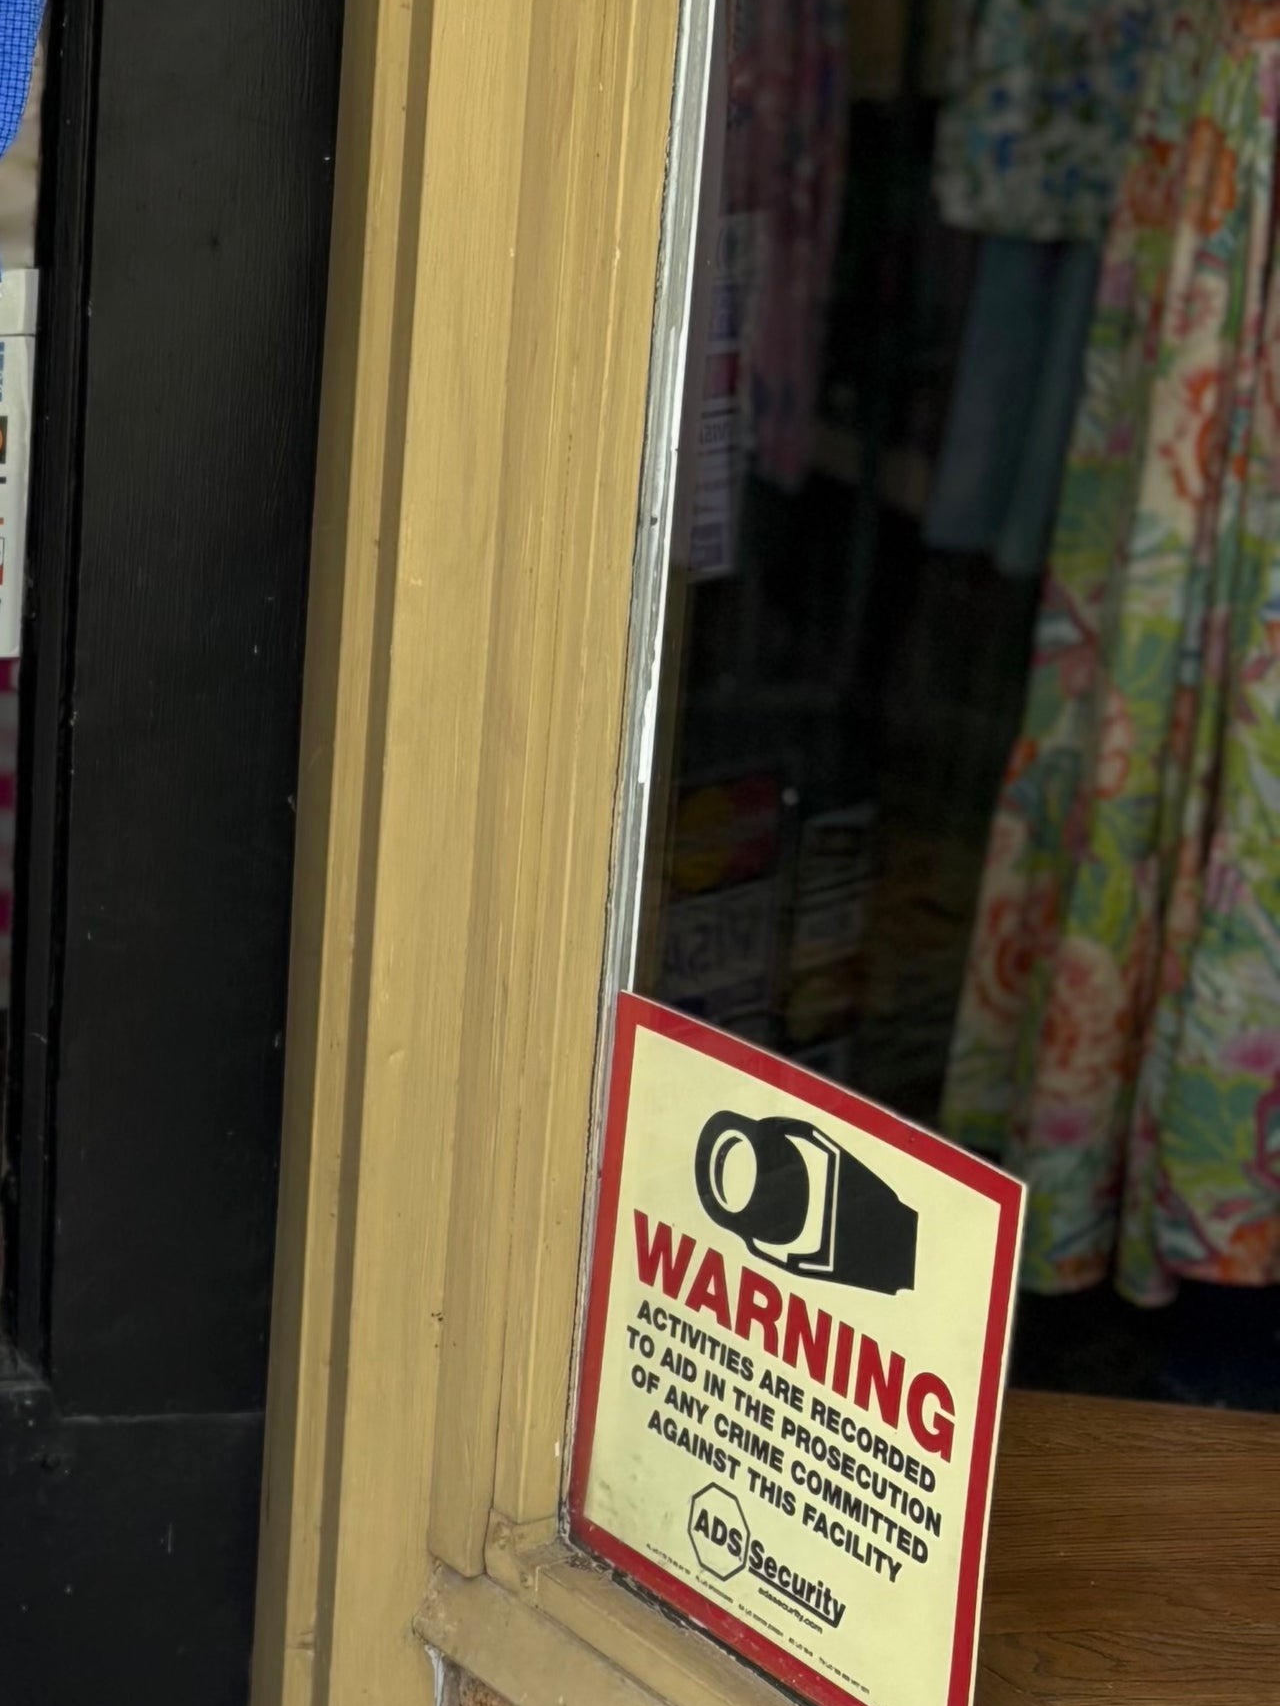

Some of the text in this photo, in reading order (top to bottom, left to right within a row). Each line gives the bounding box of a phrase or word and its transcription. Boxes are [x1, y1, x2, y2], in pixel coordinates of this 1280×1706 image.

[626, 1325, 942, 1538] TO AID IN THE PROSECUTION
[633, 1208, 956, 1462] WARNING
[637, 1299, 936, 1493] ACTIVITIES ARE RECORDED
[631, 1364, 929, 1564] OF ANY CRIME COMMITTED
[647, 1409, 903, 1584] AGAINST THIS FACILITY
[693, 1508, 743, 1558] ADS
[748, 1539, 846, 1628] Security
